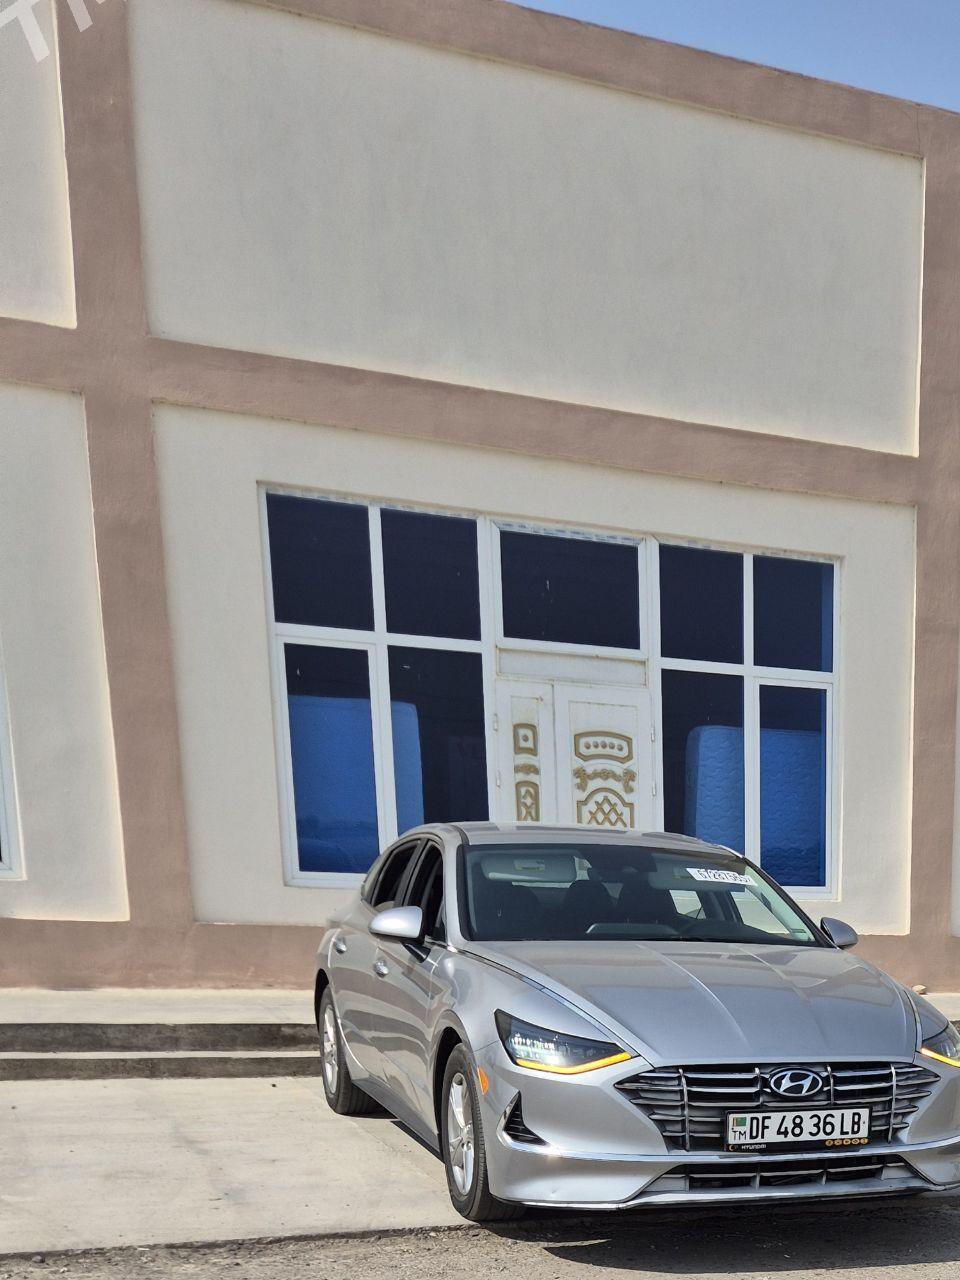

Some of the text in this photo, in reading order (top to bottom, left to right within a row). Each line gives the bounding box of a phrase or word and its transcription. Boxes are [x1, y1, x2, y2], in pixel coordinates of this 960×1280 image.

[750, 1112, 862, 1139] DF 48 36 LB
[732, 1130, 747, 1140] TM
